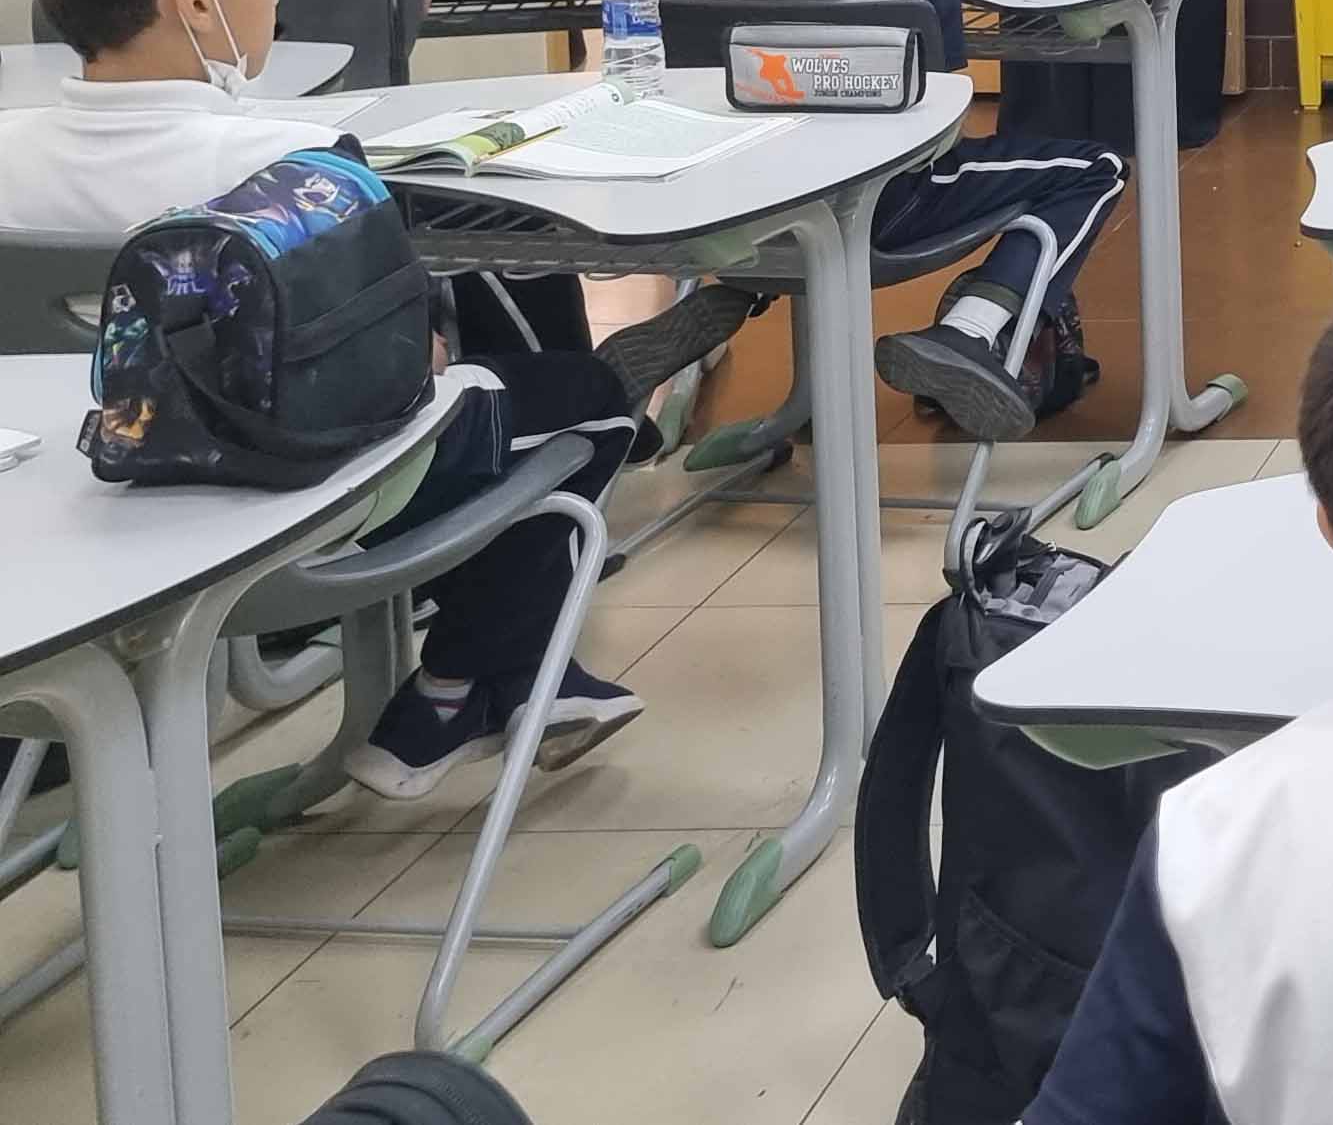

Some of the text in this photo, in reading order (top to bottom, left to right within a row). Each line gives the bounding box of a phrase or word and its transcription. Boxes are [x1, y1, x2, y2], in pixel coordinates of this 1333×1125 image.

[791, 58, 850, 74] WOLVES
[813, 74, 899, 91] PRO HOCKEY
